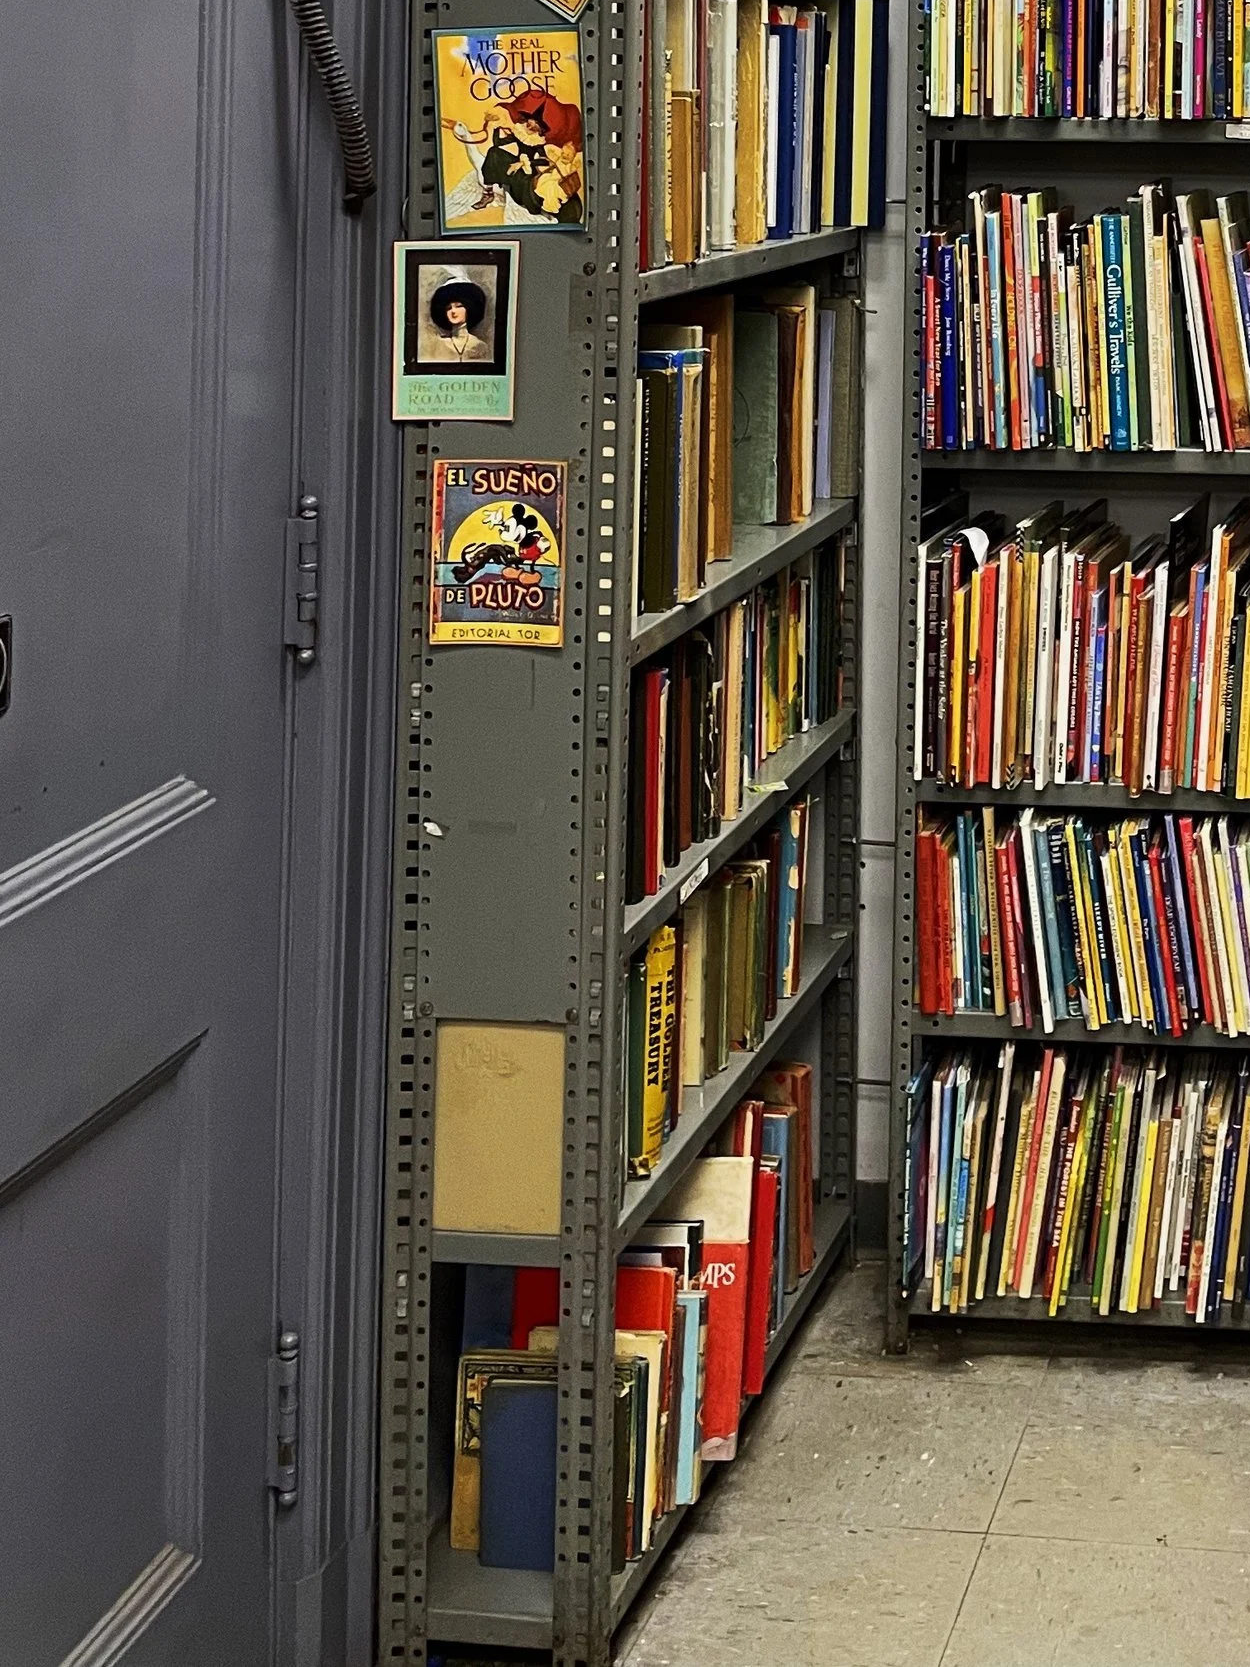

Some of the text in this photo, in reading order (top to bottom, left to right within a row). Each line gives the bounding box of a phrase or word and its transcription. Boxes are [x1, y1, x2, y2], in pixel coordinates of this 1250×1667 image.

[477, 38, 544, 51] THE REAL
[460, 50, 564, 77] MOTHER
[470, 76, 556, 101] GOOSE
[990, 297, 999, 339] Every Life
[1106, 264, 1126, 374] Gulliver's Travels
[447, 464, 557, 494] EL SUEÑO
[445, 584, 544, 608] DE PLUTO
[451, 628, 540, 640] EDITORIAL TOR
[937, 619, 948, 720] The Yankee the Seder
[1164, 895, 1173, 919] DEAR
[1094, 902, 1106, 960] SLEEPY RIVER
[647, 982, 663, 1087] TREASURY
[1051, 1141, 1076, 1248] THE FOREST IN THE SEA
